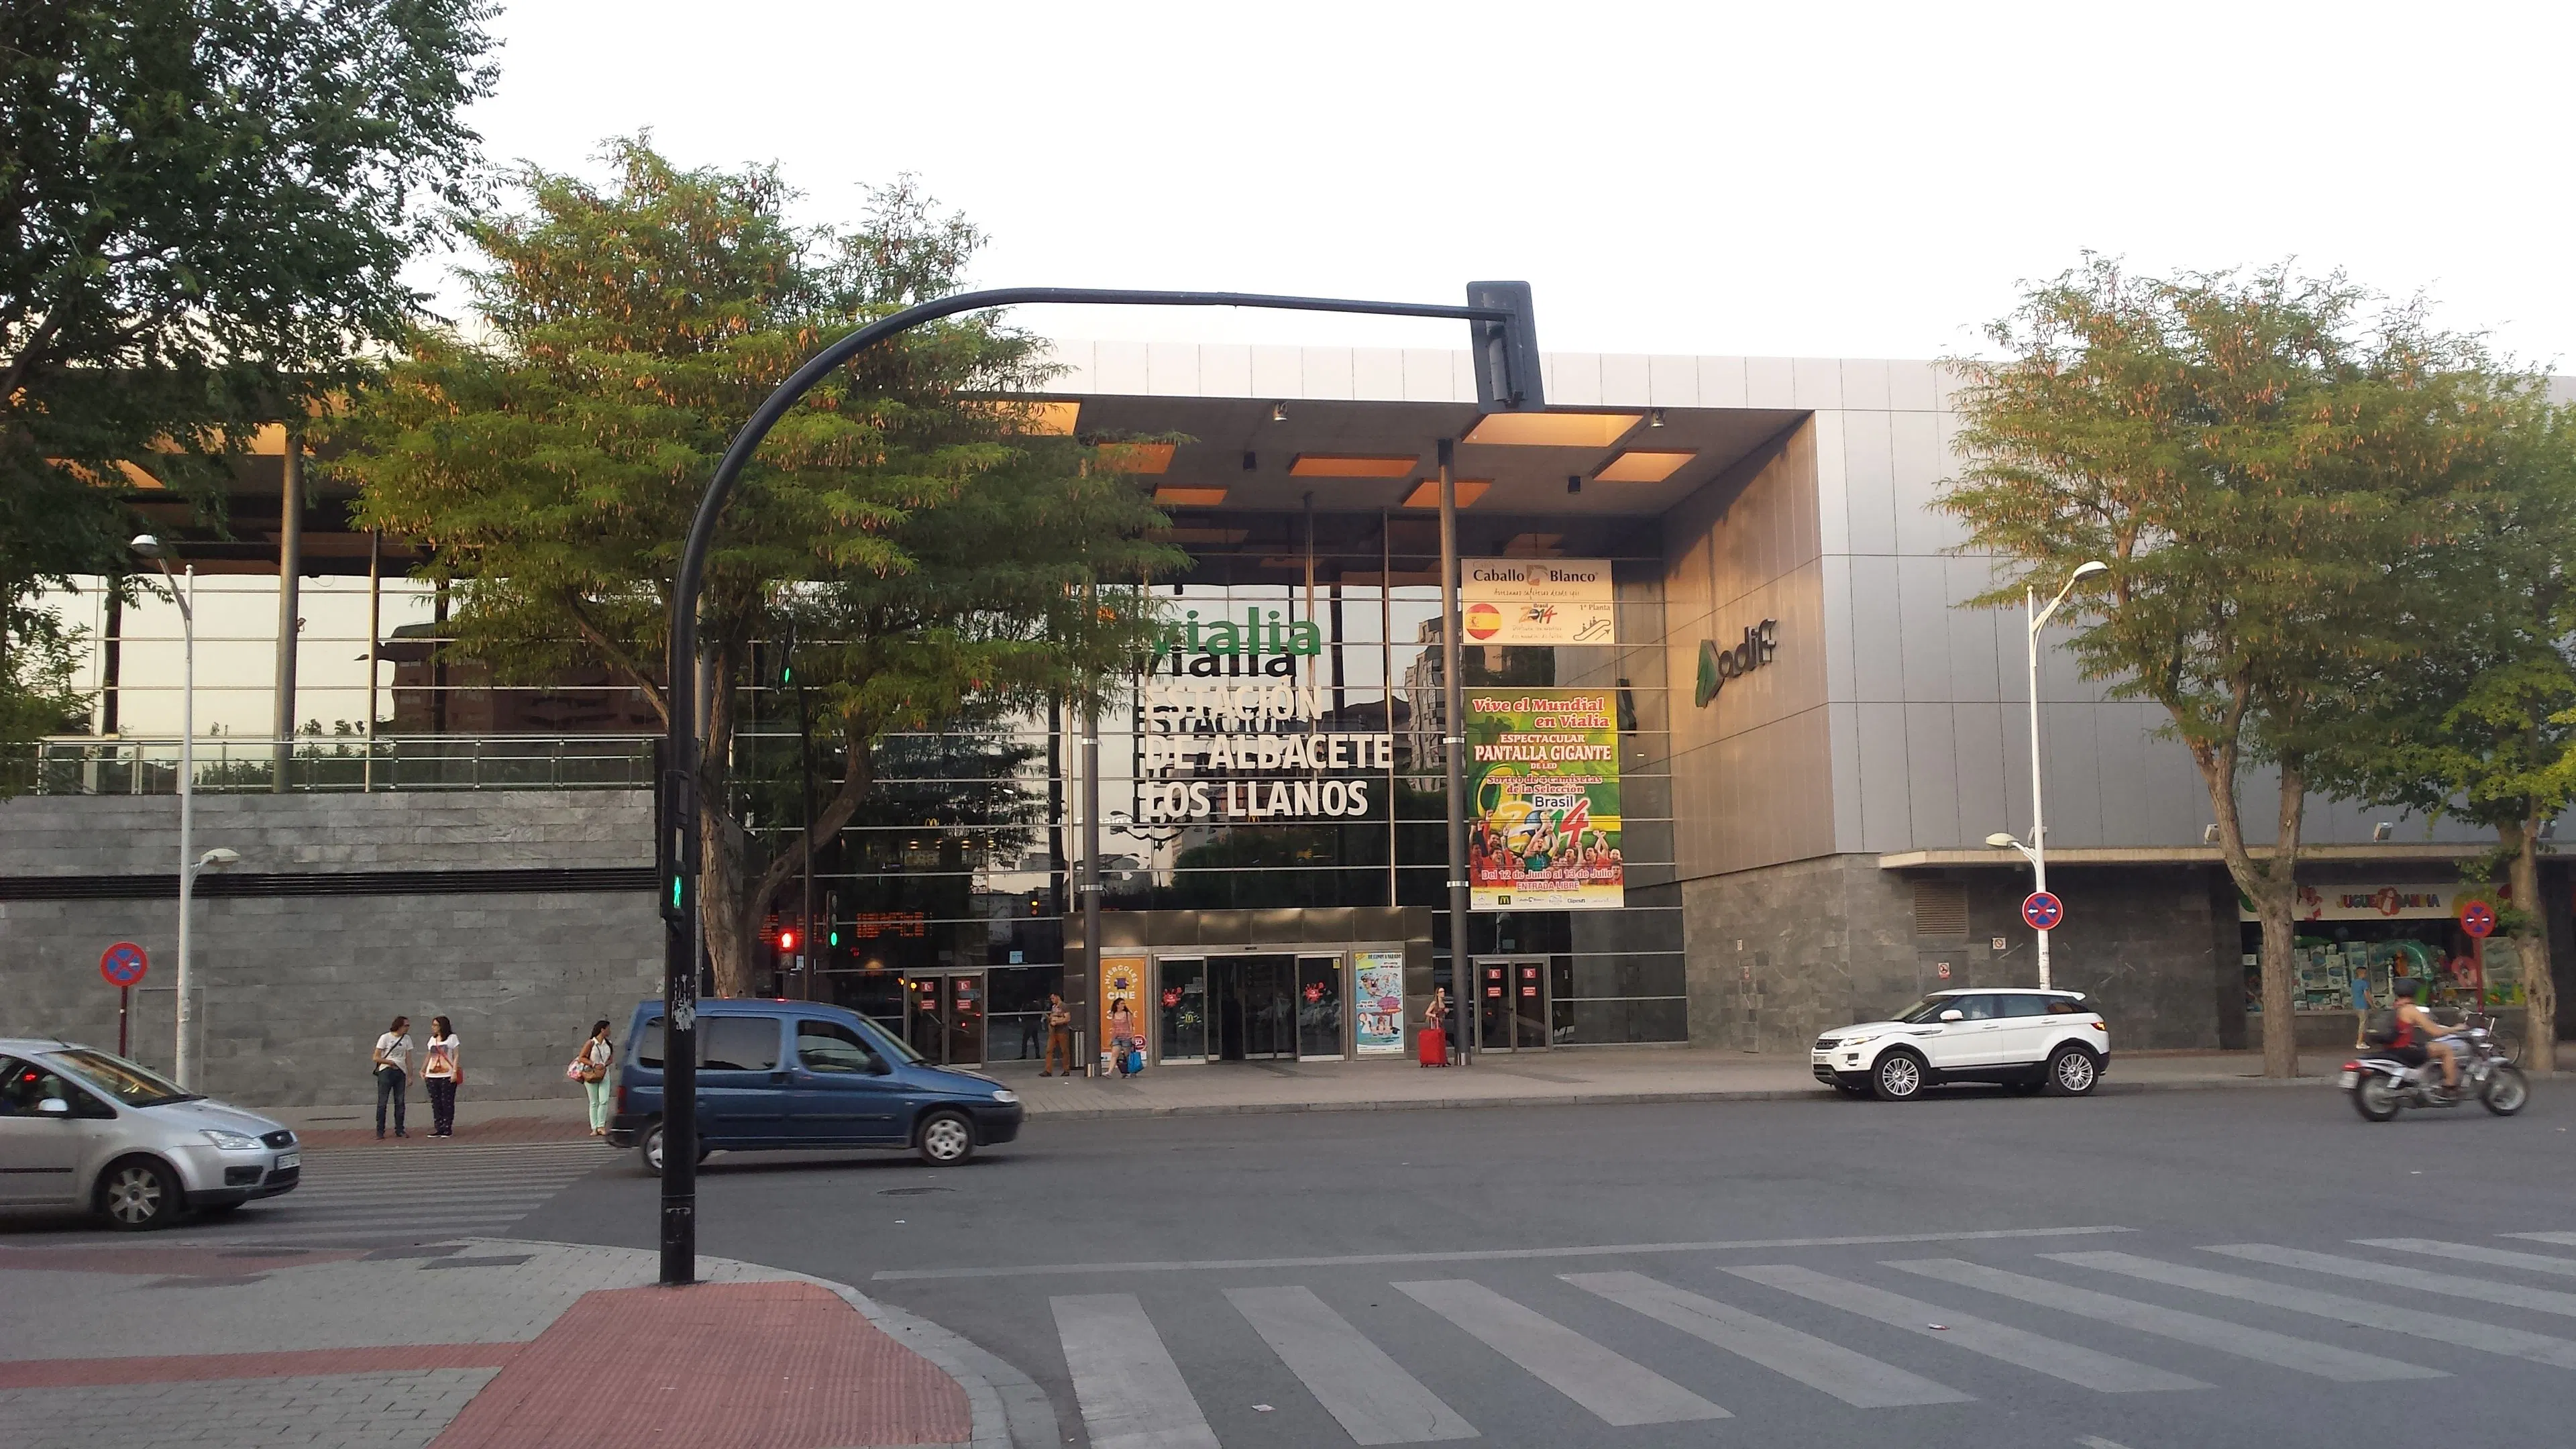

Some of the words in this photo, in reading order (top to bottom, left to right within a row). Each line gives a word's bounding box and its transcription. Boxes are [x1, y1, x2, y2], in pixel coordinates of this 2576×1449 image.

[1473, 570, 1525, 582] Caballo
[1550, 570, 1596, 582] Blanco
[1519, 605, 1558, 624] 2014
[1152, 606, 1321, 655] vialia
[1719, 619, 1776, 678] adif
[1146, 674, 1323, 720] ESTACIÓN
[1472, 698, 1511, 712] Vive
[1513, 696, 1529, 712] el
[1532, 696, 1605, 712] Mundial
[1534, 716, 1556, 728] en
[1559, 714, 1610, 728] Vialia
[1500, 735, 1585, 743] ESPECTACULAR
[1146, 735, 1195, 769] DE
[1208, 734, 1394, 769] ALBACETE
[1474, 745, 1548, 761] PANTALLA
[1550, 745, 1611, 761] GIGANTE
[1487, 775, 1523, 784] Sorteo
[1524, 774, 1538, 784] de
[1548, 774, 1603, 784] camisetas
[1507, 785, 1520, 794] de
[1521, 785, 1534, 794] la
[1534, 784, 1585, 794] Selección
[1146, 782, 1210, 817] LOS
[1227, 781, 1368, 816] LLANOS
[1535, 796, 1574, 807] Brasil
[1481, 870, 1497, 879] Del
[1499, 870, 1511, 879] 12
[1512, 869, 1524, 879] de
[1525, 869, 1551, 879] Junio
[1552, 869, 1562, 879] al
[1564, 869, 1574, 879] 13
[1576, 869, 1589, 878] de
[1590, 868, 1613, 878] Julio
[1516, 881, 1554, 890] ENTRADA
[1556, 881, 1580, 890] LIBRE
[1107, 991, 1136, 1000] CINE
